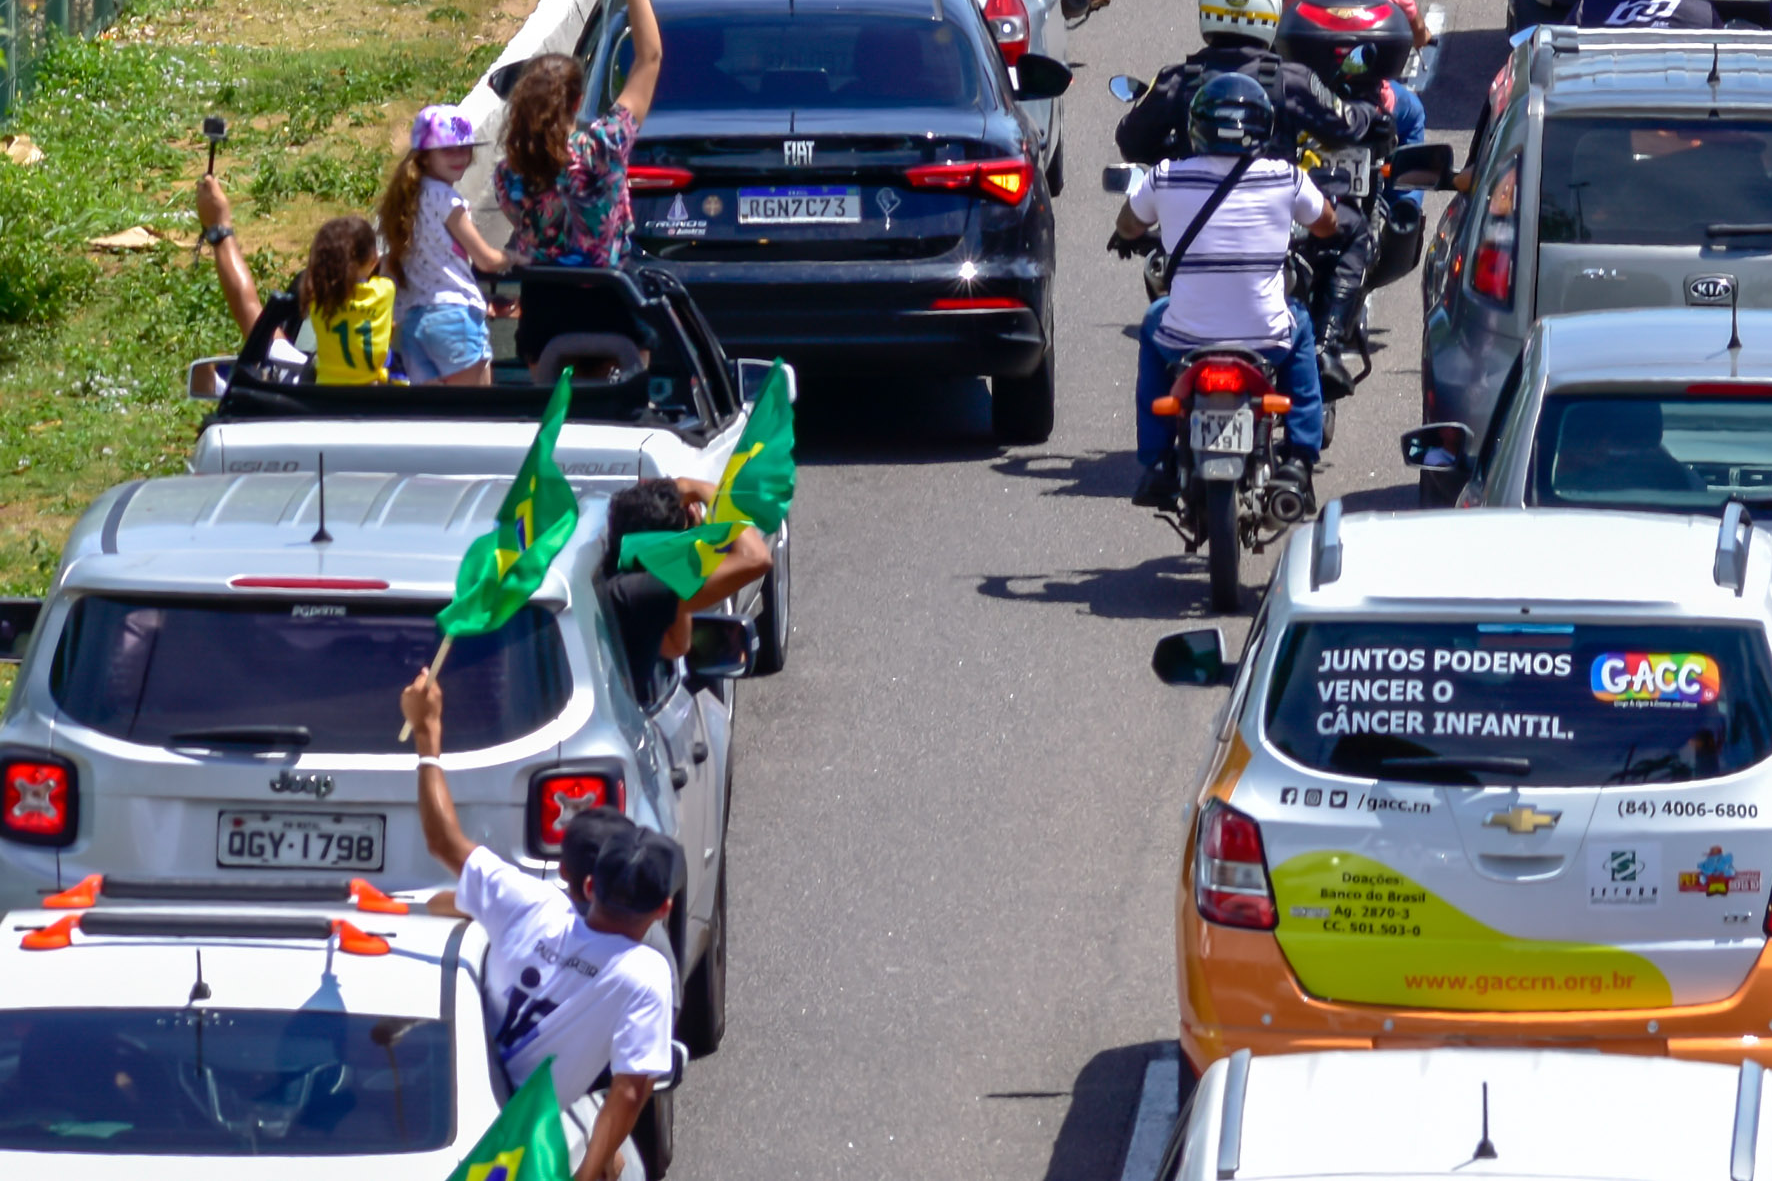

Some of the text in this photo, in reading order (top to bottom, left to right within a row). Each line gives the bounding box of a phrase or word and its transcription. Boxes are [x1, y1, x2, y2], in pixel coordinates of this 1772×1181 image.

[784, 140, 815, 166] FIAT
[749, 198, 847, 218] RGN7C73
[1698, 283, 1727, 296] KIA
[332, 319, 377, 373] 11
[1318, 649, 1573, 677] JUNTOS PODEMOS
[1600, 658, 1703, 695] GACC
[1317, 680, 1454, 704] VENCER O
[1316, 704, 1575, 740] CÂNCER INFANTIL.
[269, 769, 335, 800] Jeep
[1617, 800, 1759, 819] (84) 4006-6800
[1319, 888, 1427, 904] Banco do Brasil
[1403, 971, 1637, 995] www.gaccrn.org.br
